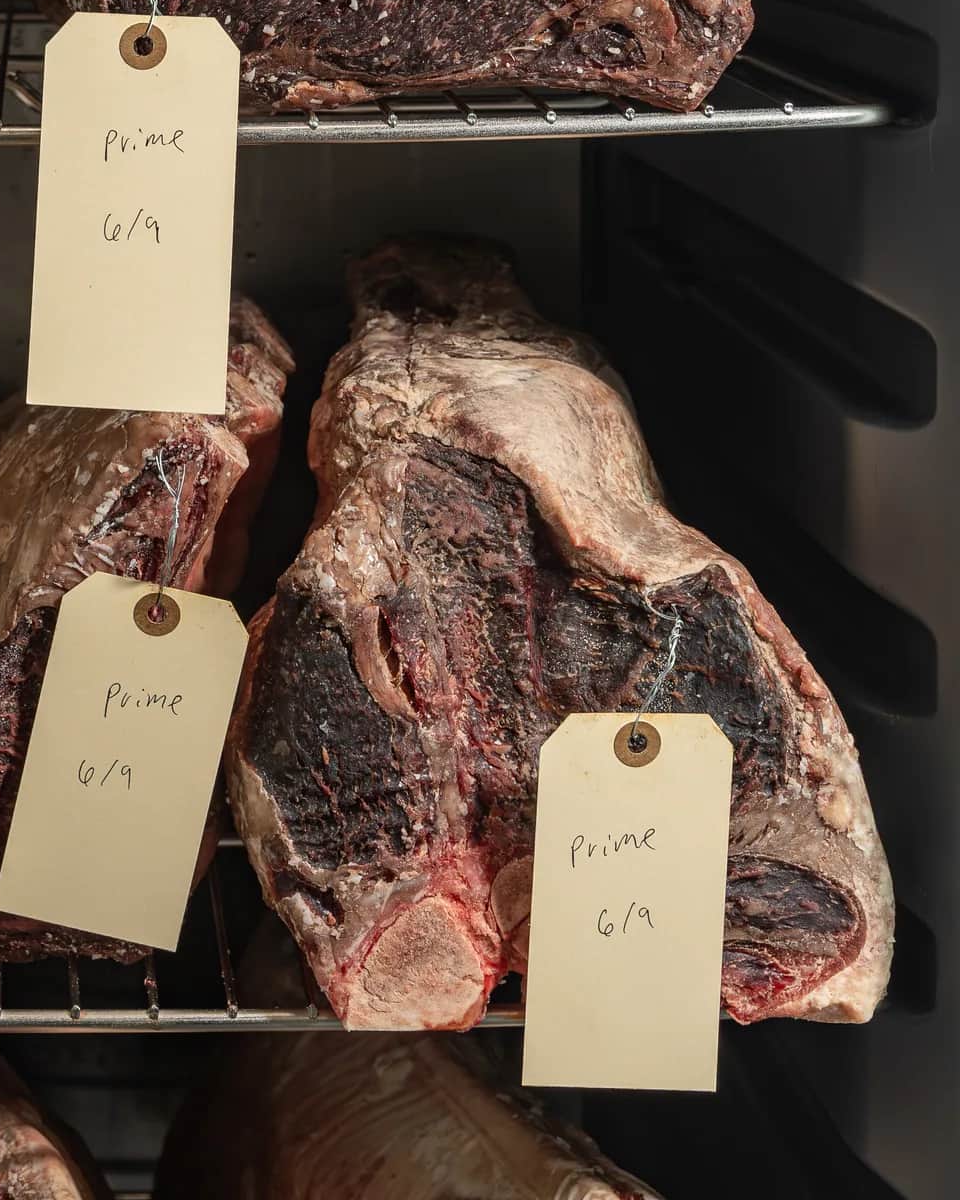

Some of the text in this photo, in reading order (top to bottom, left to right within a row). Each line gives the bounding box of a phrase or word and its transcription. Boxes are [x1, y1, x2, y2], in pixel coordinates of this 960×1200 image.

[103, 208, 161, 245] 6/9
[78, 759, 132, 791] 6/9
[597, 901, 655, 938] 6/9
